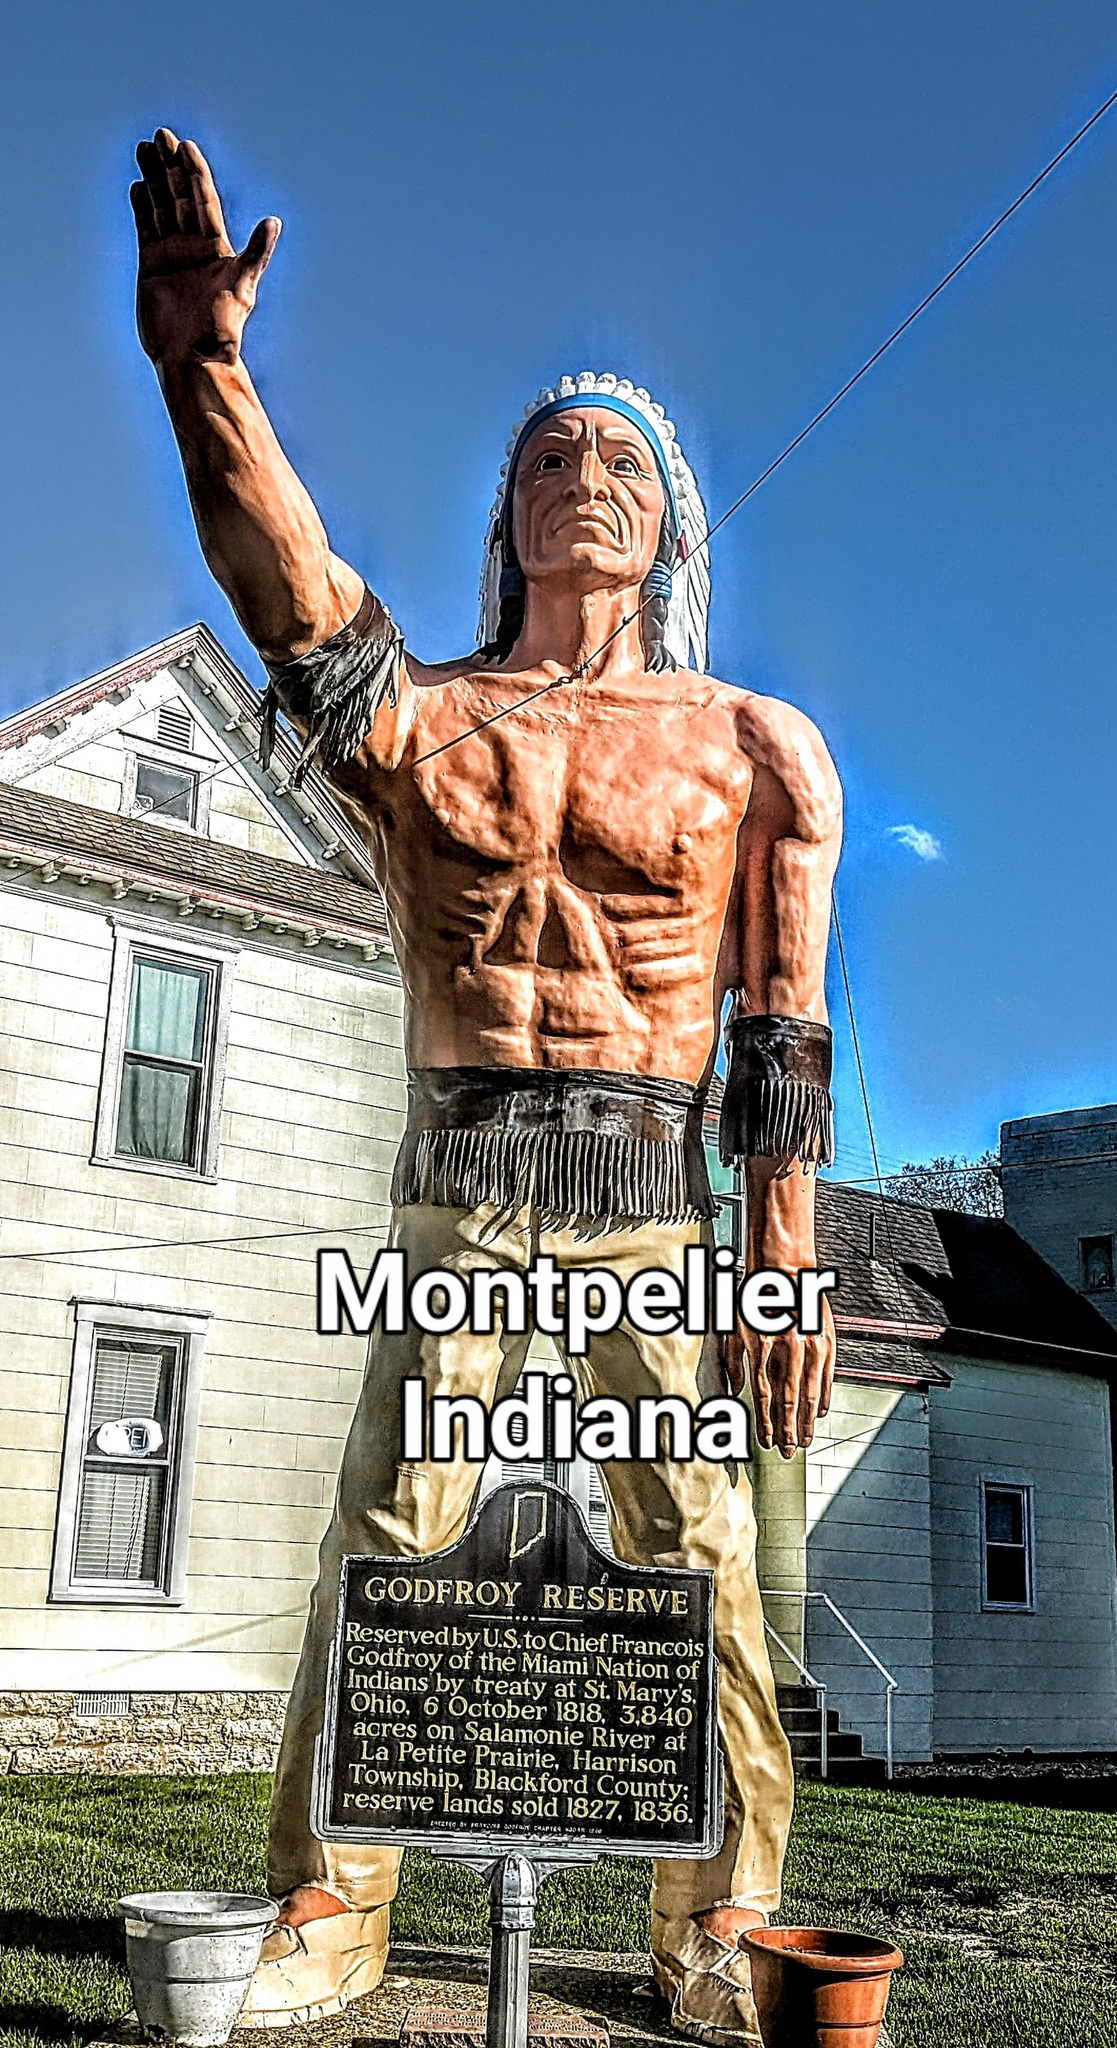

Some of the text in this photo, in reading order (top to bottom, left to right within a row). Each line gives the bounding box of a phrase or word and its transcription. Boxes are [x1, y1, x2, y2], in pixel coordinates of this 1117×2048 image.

[364, 1577, 689, 1615] GODFROY RESERVE
[345, 1622, 704, 1657] Reserved by U.S. to Chief Francois
[346, 1645, 701, 1682] Godfroy of the Miami Nation of
[346, 1669, 432, 1692] Indians
[436, 1672, 465, 1698] by
[473, 1676, 546, 1701] treaty
[553, 1680, 578, 1699] at
[583, 1677, 611, 1699] St.
[423, 1697, 438, 1716] 6
[448, 1695, 548, 1720] October
[353, 1721, 687, 1752] acres on Salamonie River at
[360, 1741, 677, 1775] La Petite Prairie, Harrison
[348, 1763, 464, 1793] Township,
[474, 1768, 589, 1795] Blackford
[342, 1792, 694, 1825] reserve lands sold 1827, 1836.
[533, 1825, 562, 1833] CHAPTER
